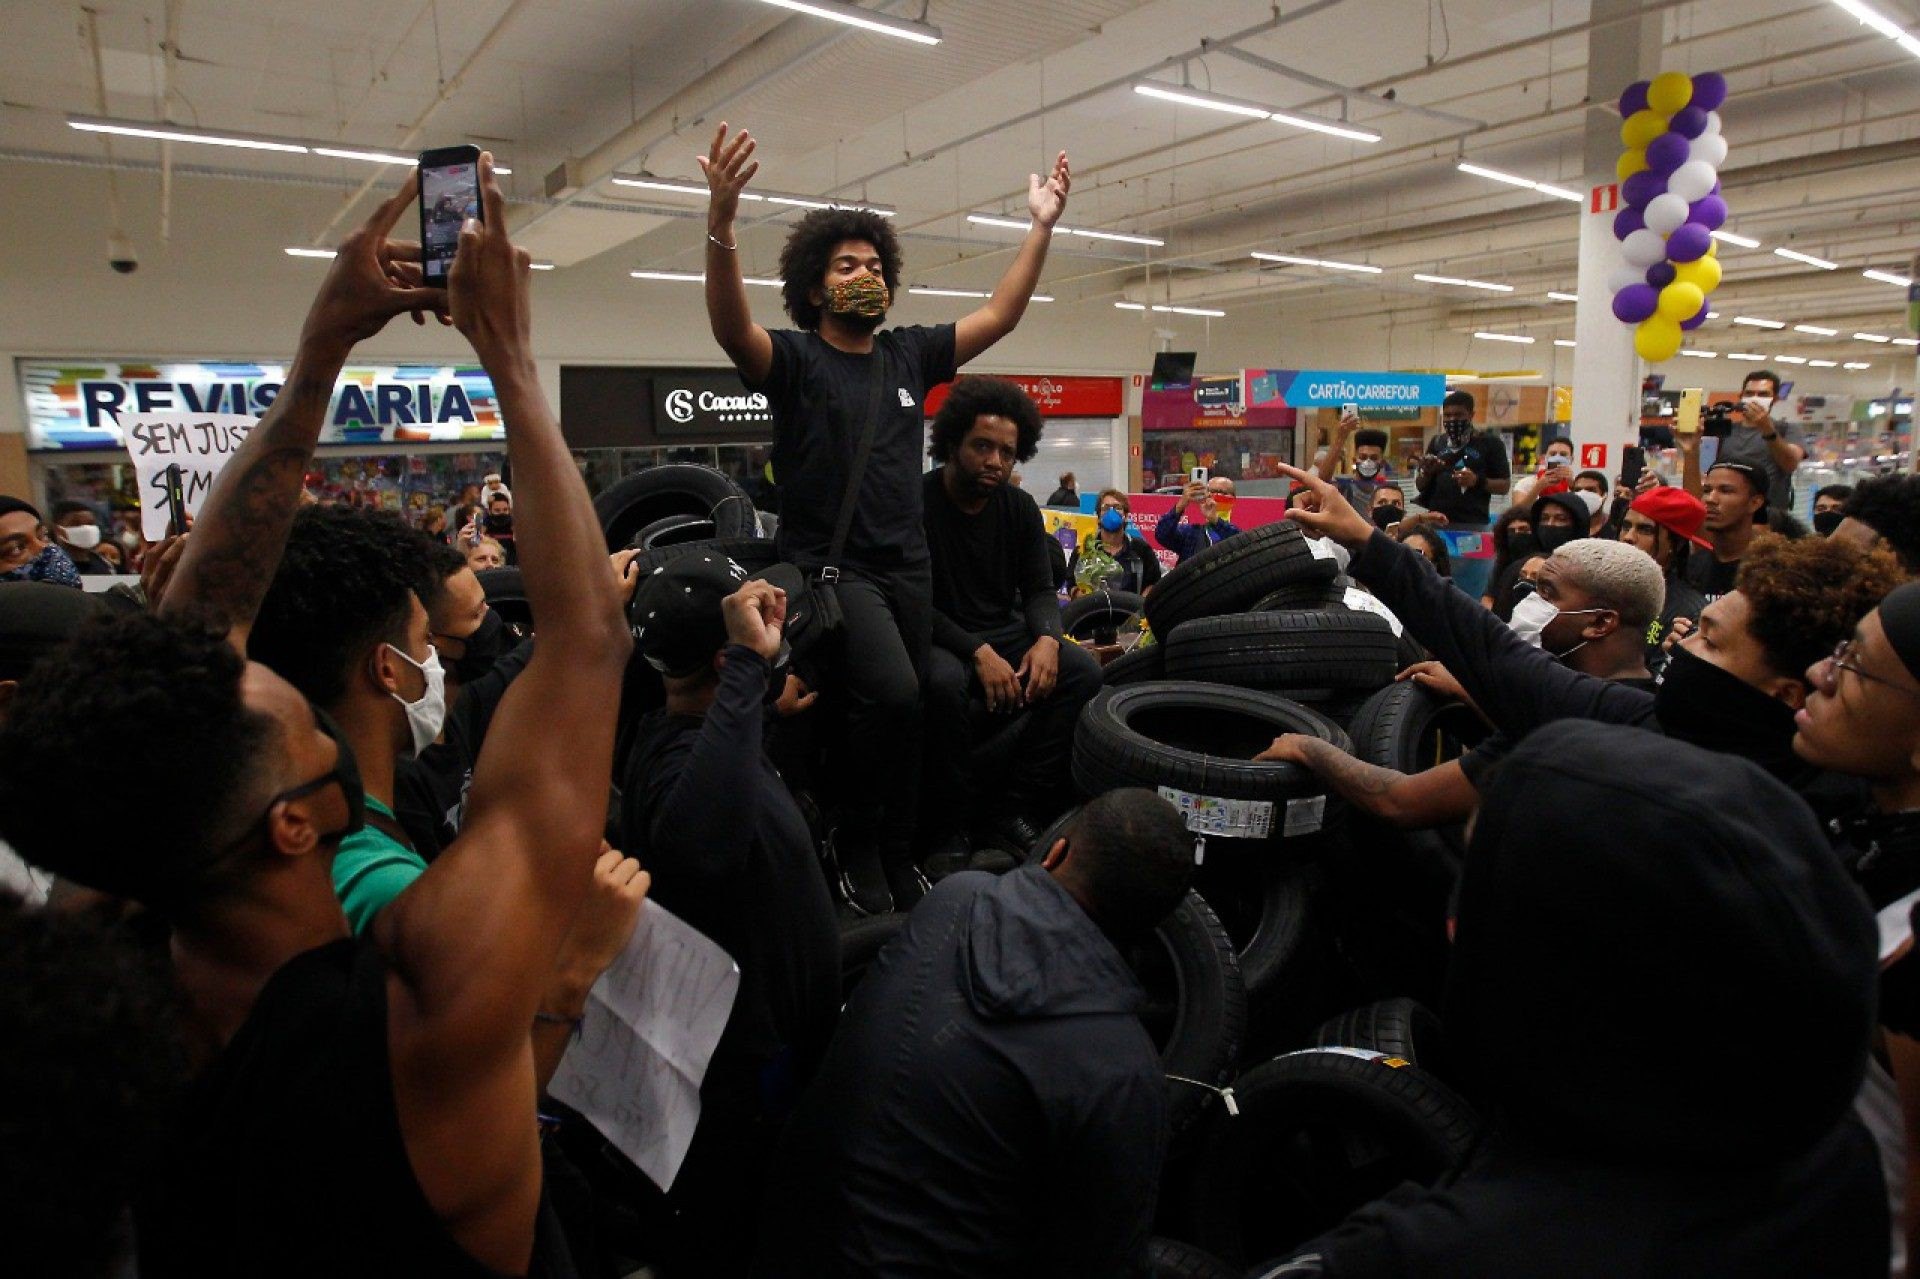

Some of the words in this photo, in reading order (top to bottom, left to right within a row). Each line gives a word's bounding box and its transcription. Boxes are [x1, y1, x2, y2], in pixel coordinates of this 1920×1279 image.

[82, 382, 476, 427] REVISARIA
[1309, 381, 1355, 399] CARTÃO
[1357, 384, 1420, 400] CARREFOUR
[132, 422, 192, 455] SEM
